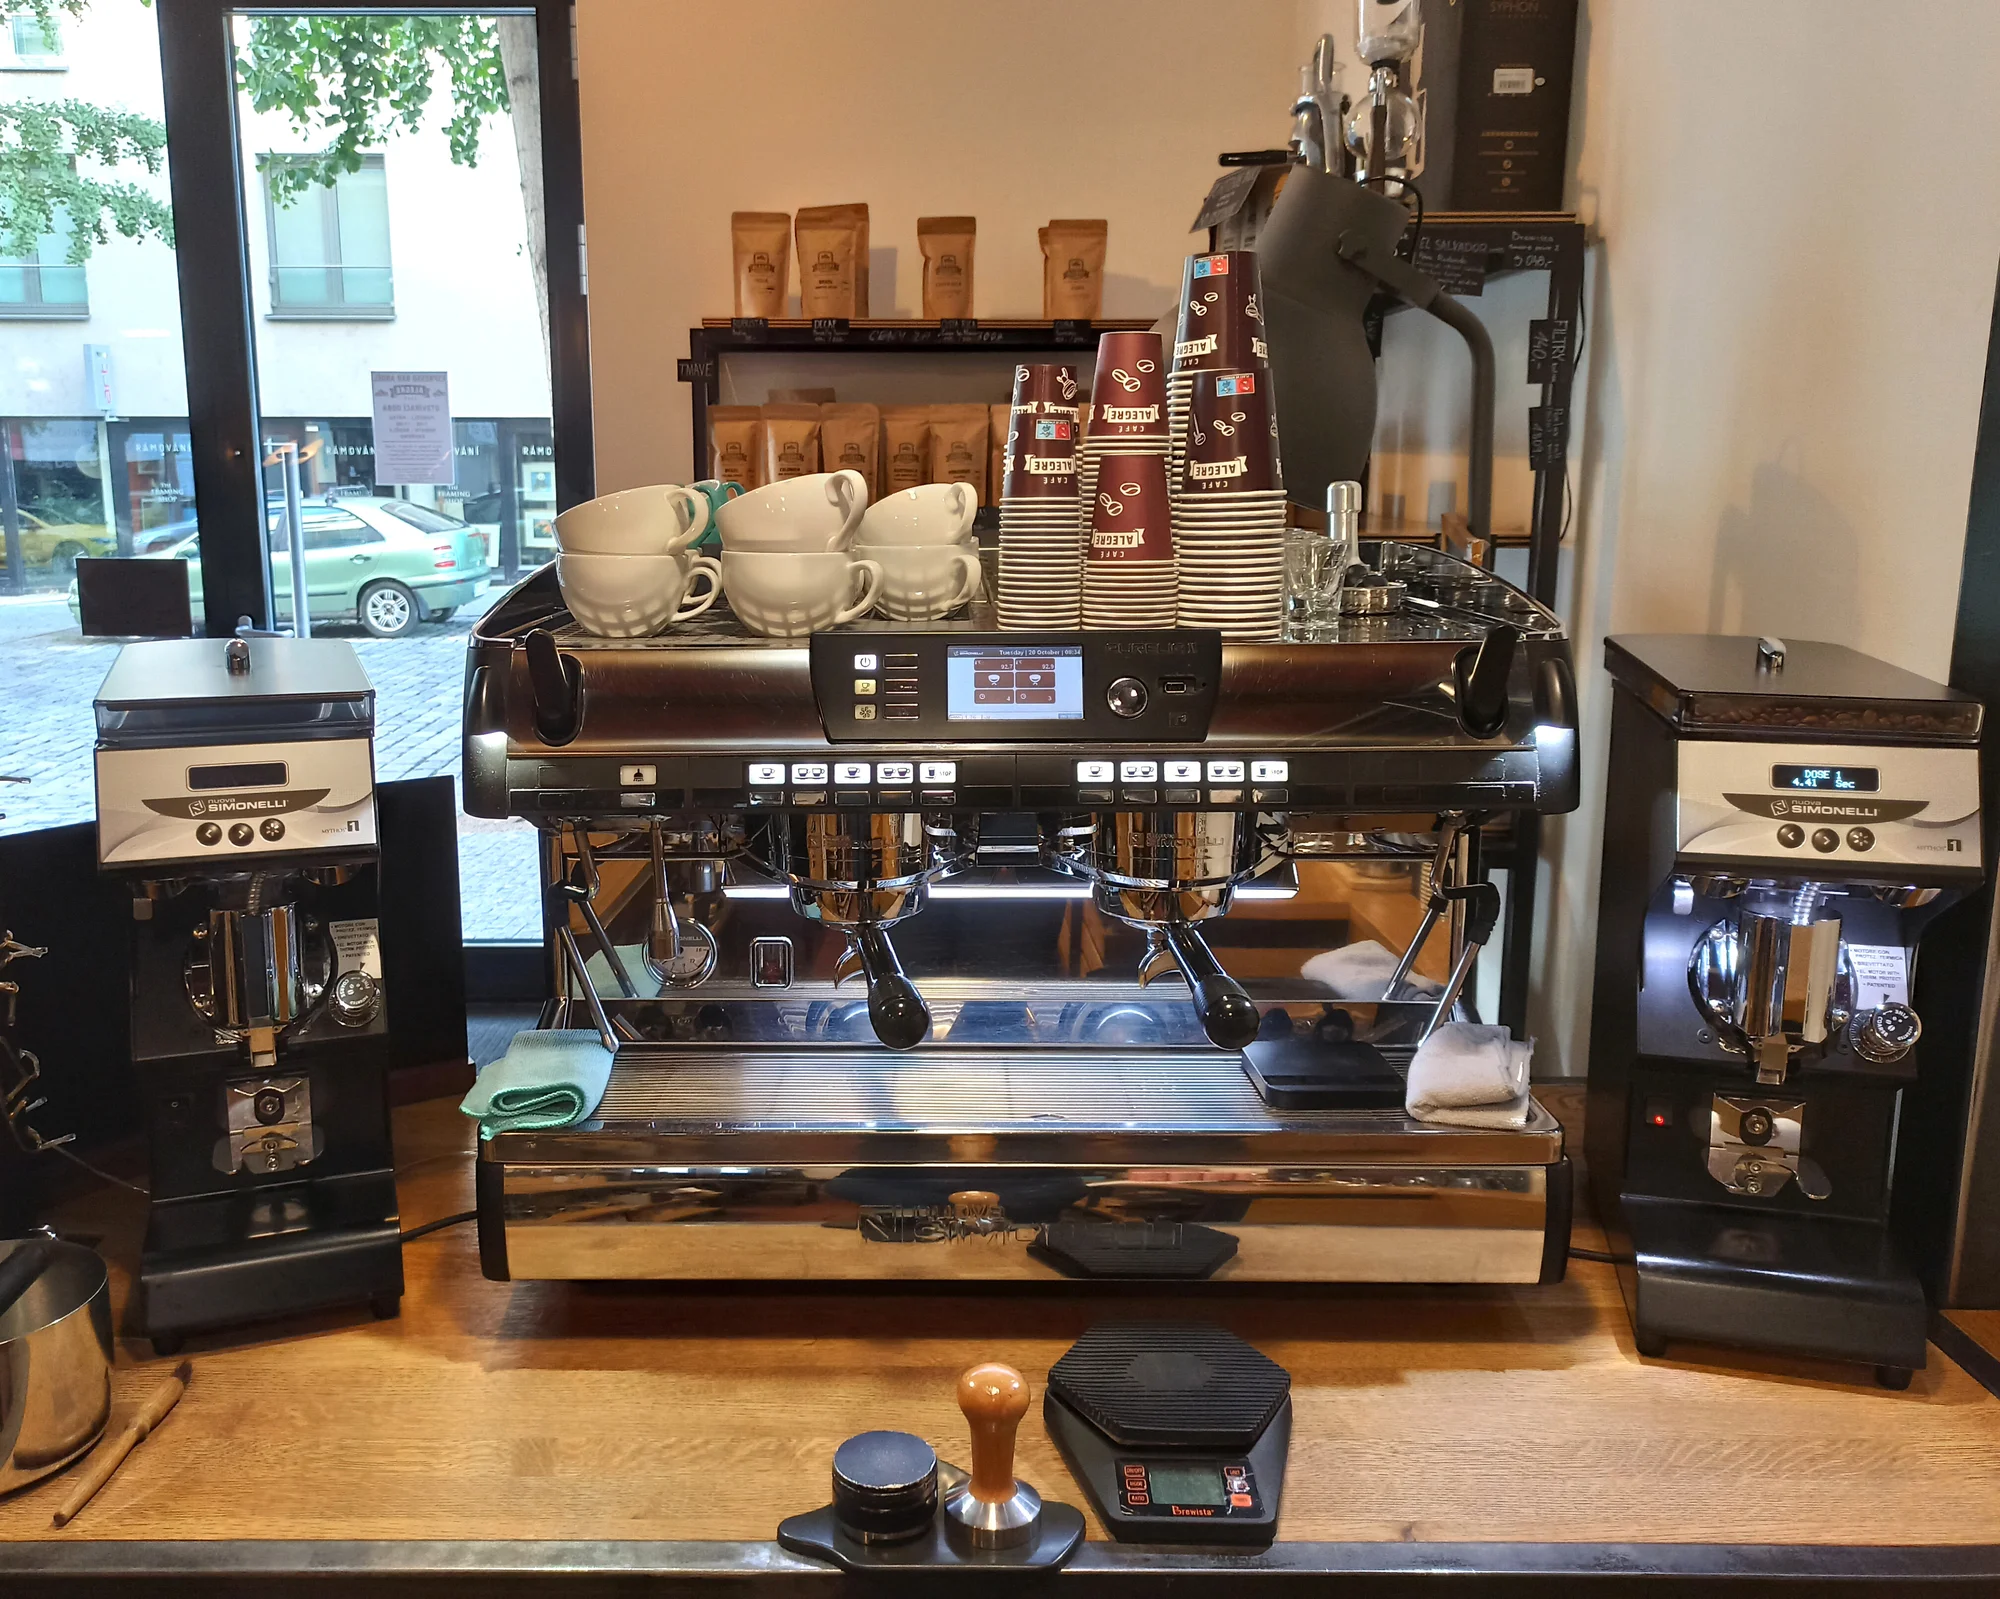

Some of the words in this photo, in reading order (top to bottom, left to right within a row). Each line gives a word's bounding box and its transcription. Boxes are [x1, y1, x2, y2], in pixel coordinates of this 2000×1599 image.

[1434, 238, 1488, 253] SALVADOR
[1551, 319, 1569, 362] FILTRY
[1110, 409, 1152, 421] ALEGRE
[1118, 425, 1145, 433] CAFÉ
[326, 445, 375, 455] RÁMOVÁN
[1033, 460, 1072, 471] ALEGRE
[1195, 463, 1236, 477] ALEGRE
[1043, 477, 1068, 485] CAFÉ
[1201, 480, 1228, 489] CAFÉ
[1095, 535, 1134, 545] ALEGRE
[1100, 550, 1125, 559] CAFÉ
[1804, 769, 1831, 779] DOSE
[1835, 771, 1842, 779] 1
[1792, 777, 1818, 787] 4.41
[1835, 779, 1856, 789] Sec
[208, 800, 287, 813] SIMONELLI
[1791, 804, 1879, 817] SIMONELLI
[1876, 1016, 1889, 1038] COARSE
[1171, 1505, 1212, 1516] Brewista
